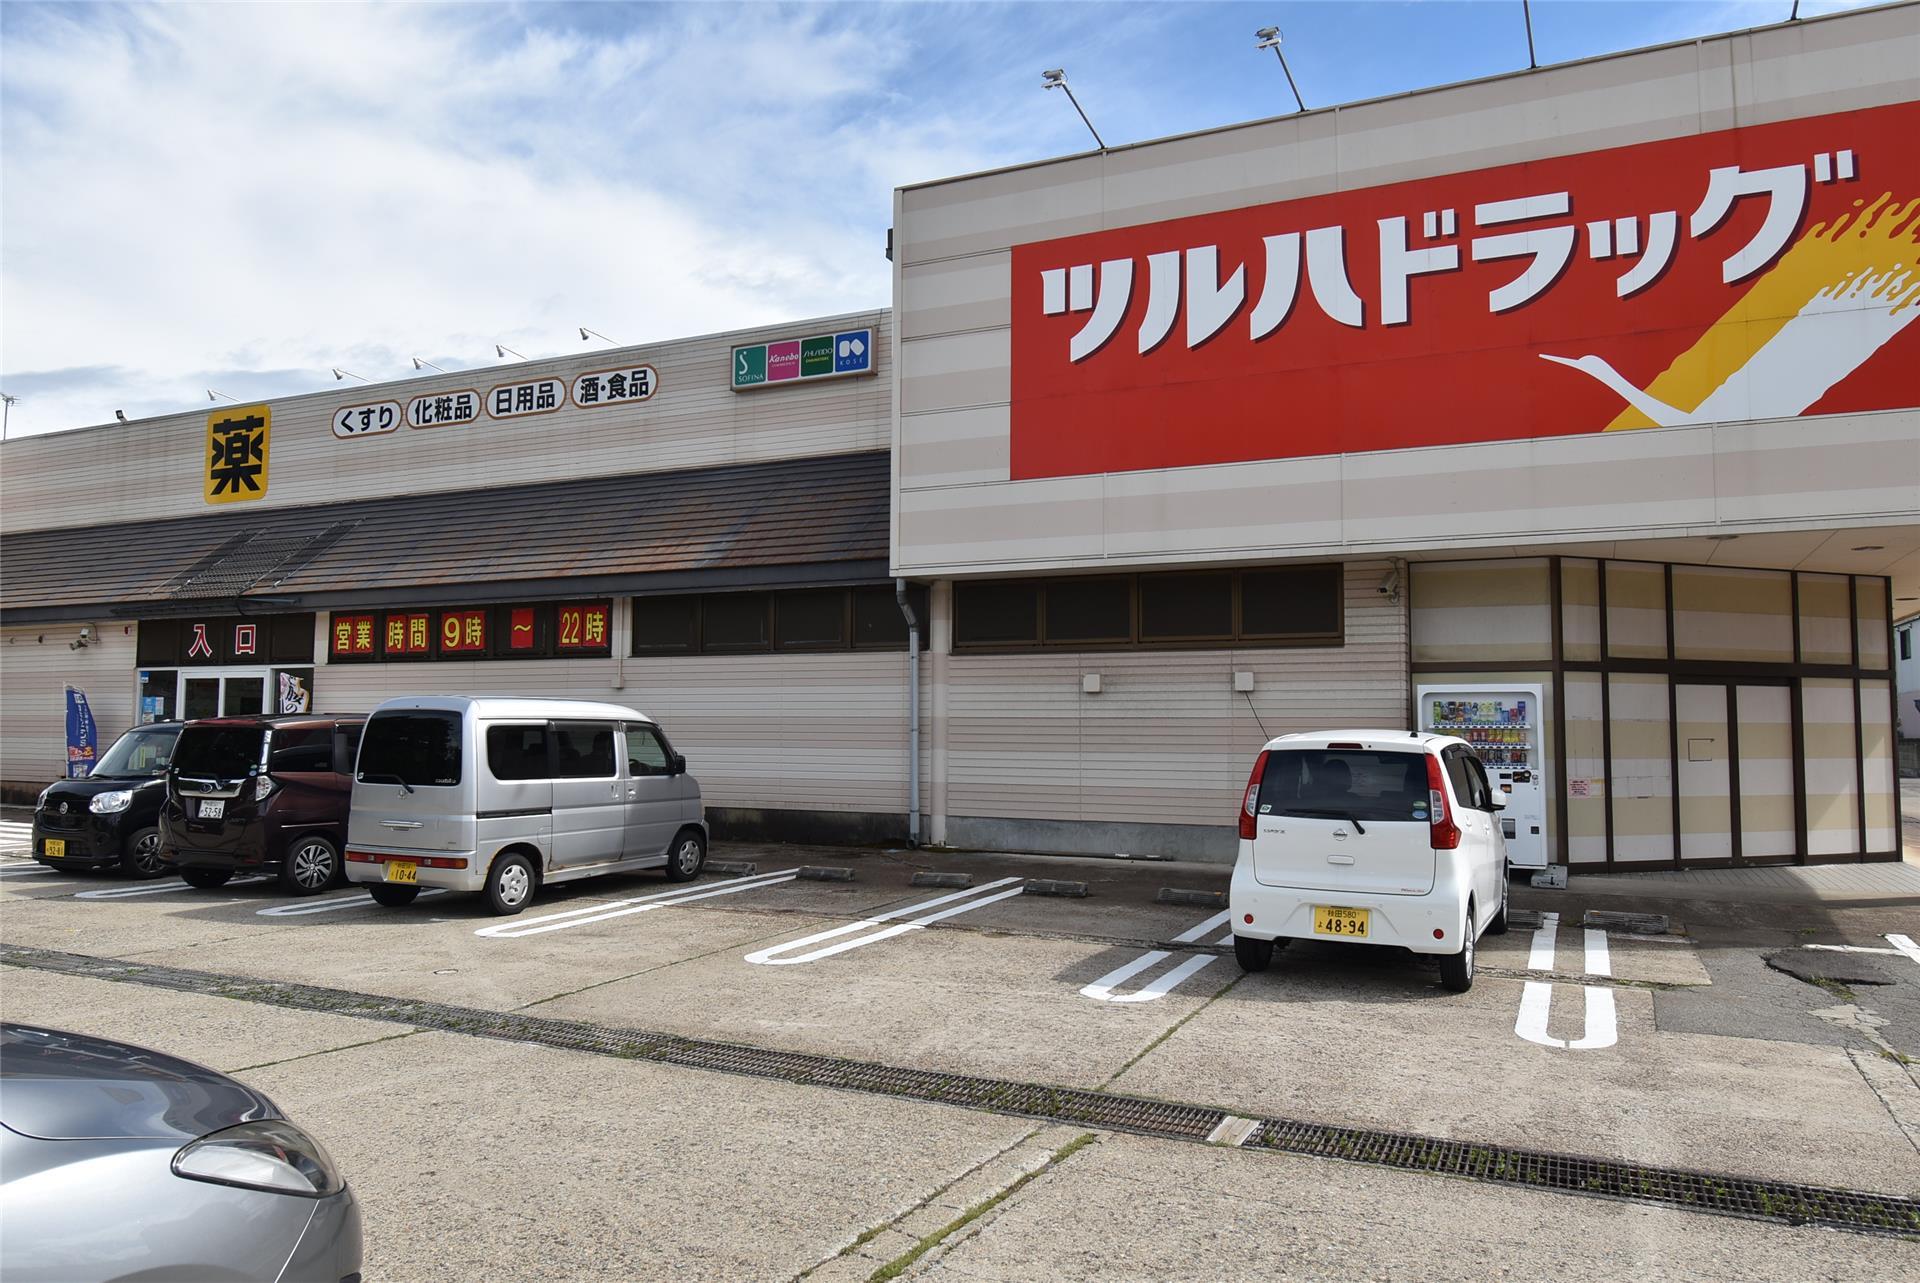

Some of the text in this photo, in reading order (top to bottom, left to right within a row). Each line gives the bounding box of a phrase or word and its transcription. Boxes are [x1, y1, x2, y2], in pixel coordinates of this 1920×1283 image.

[1041, 149, 1854, 362] ツルハドラッグ
[769, 352, 799, 363] Kanebo
[580, 369, 649, 404] 酒・食品
[737, 373, 764, 383] SOFINA
[415, 394, 472, 425] 化粧品
[495, 382, 555, 414] 日用品
[340, 406, 393, 433] くすり
[210, 415, 264, 496] 薬
[188, 623, 256, 657] 入口
[1325, 918, 1364, 935] 48-94
